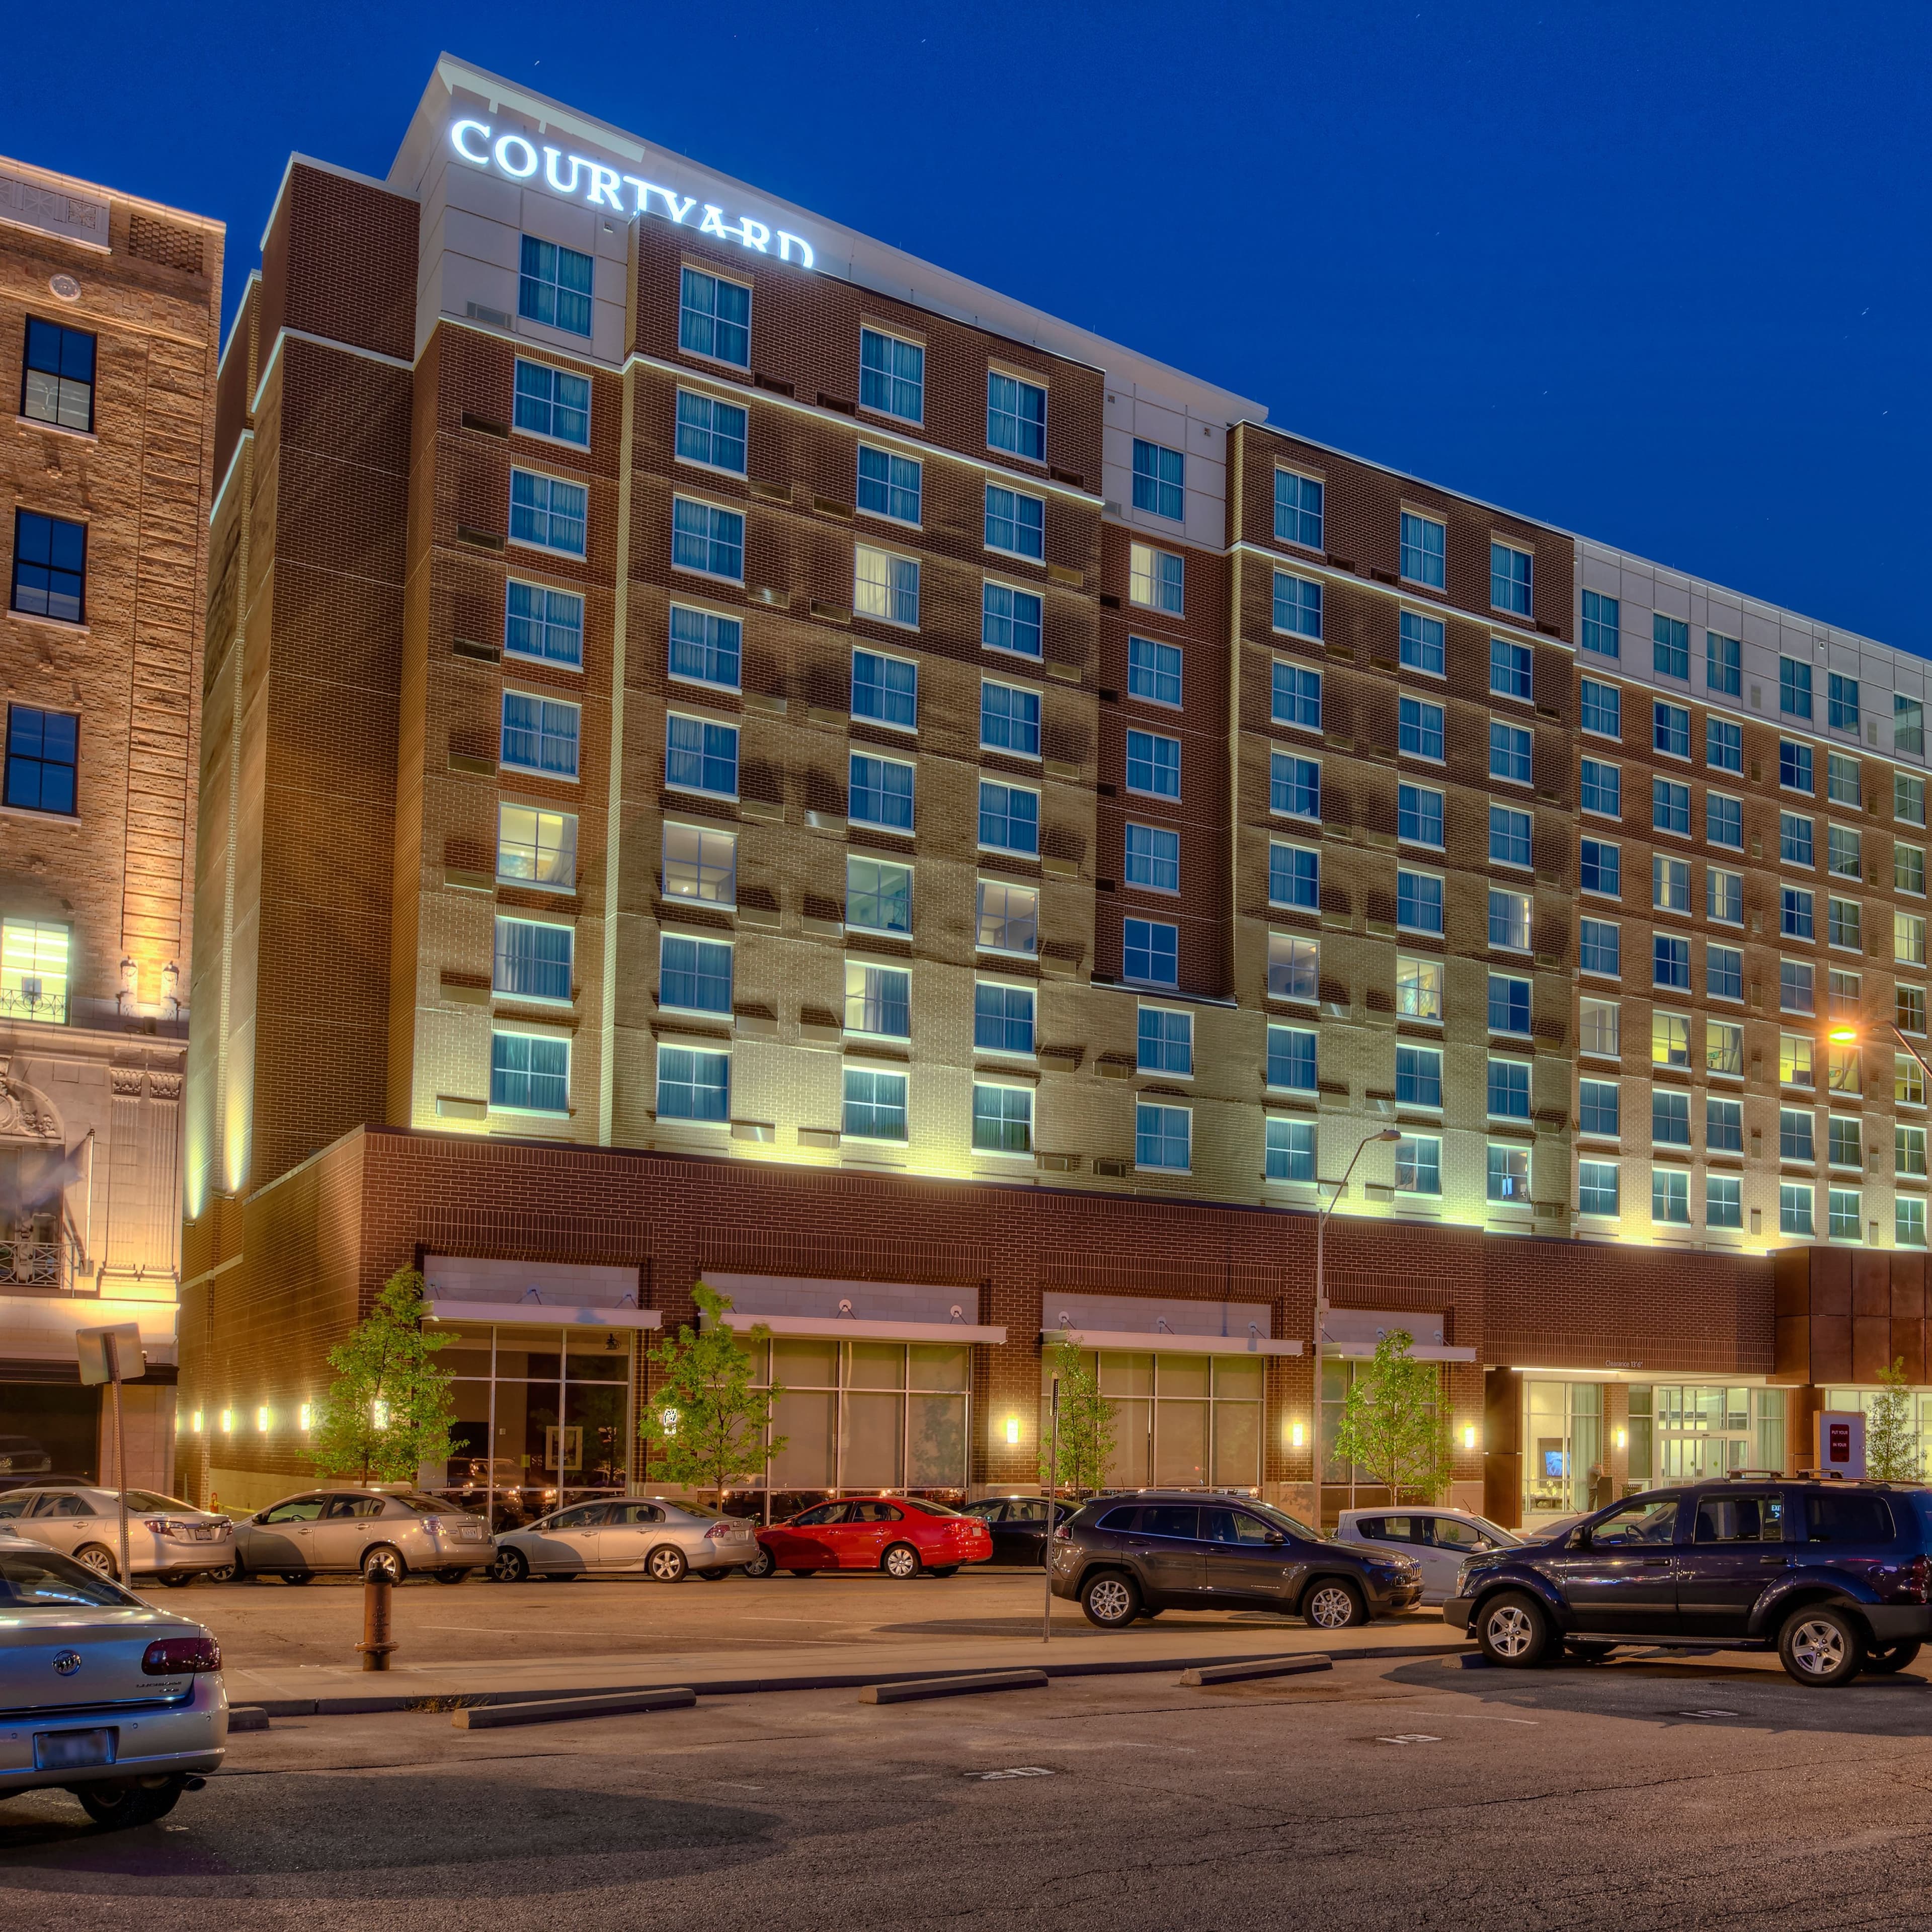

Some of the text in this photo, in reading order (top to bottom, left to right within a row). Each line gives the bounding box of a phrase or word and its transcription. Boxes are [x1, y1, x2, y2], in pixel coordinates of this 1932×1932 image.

[451, 120, 814, 268] COURTYARD
[1376, 1734, 1442, 1743] 19
[963, 1767, 1055, 1780] 20
